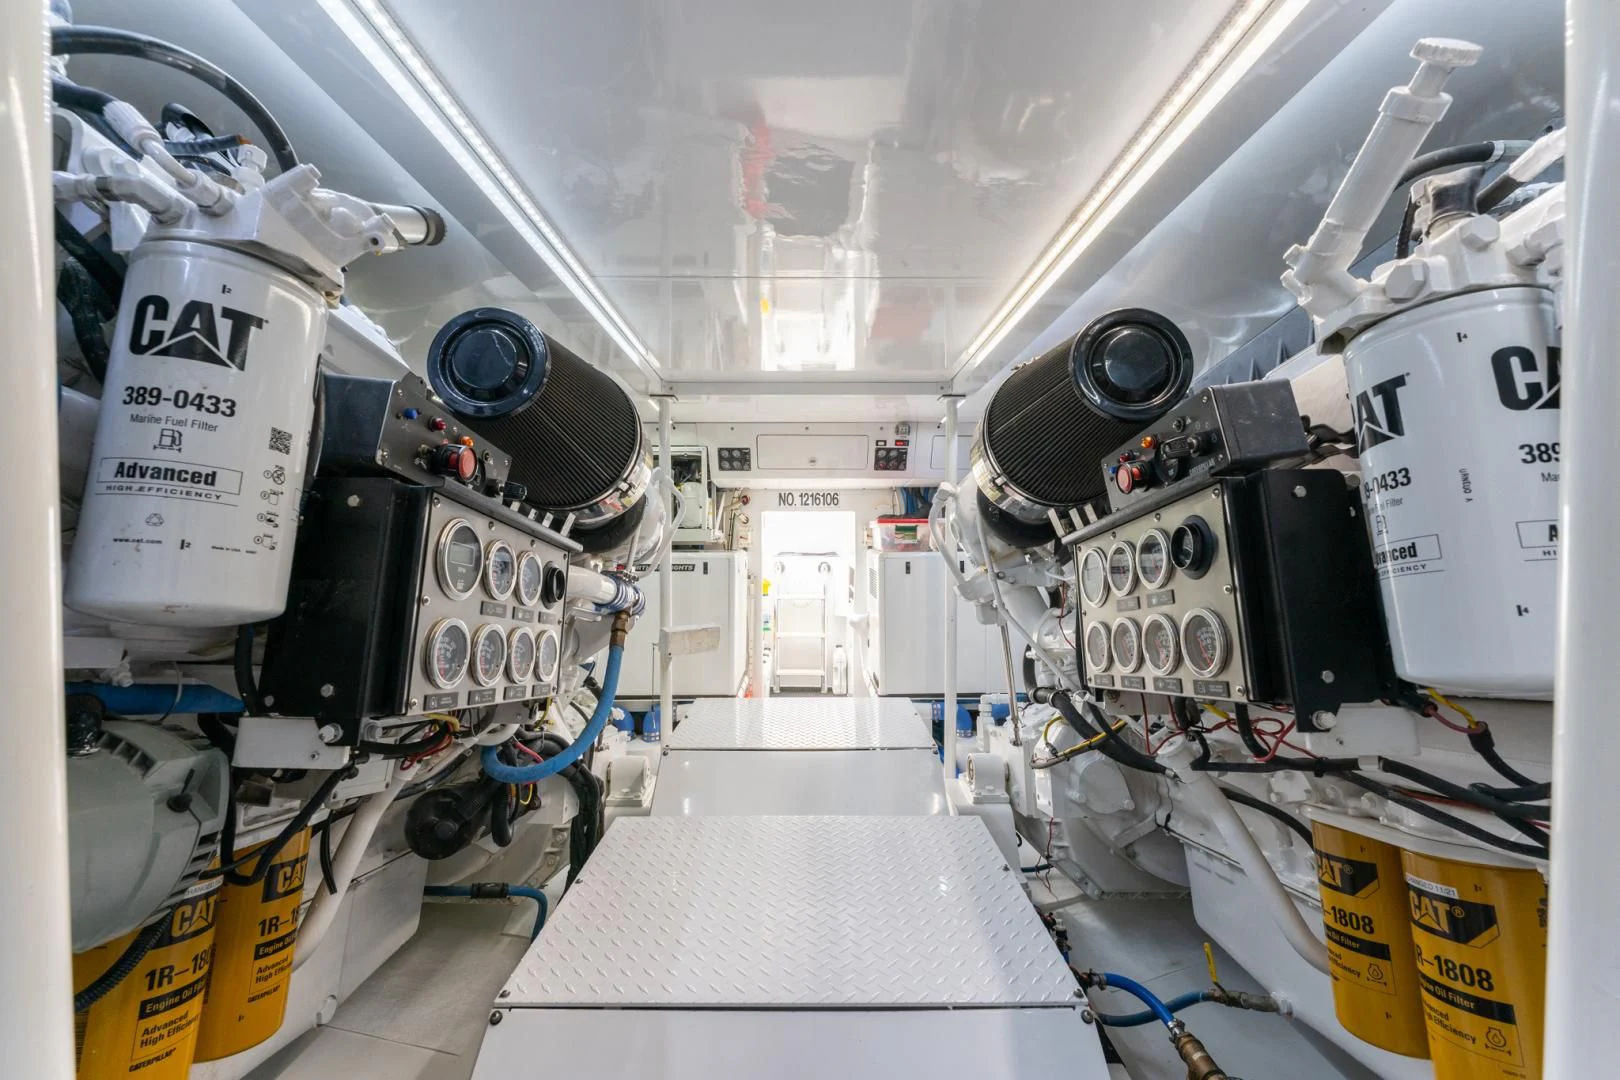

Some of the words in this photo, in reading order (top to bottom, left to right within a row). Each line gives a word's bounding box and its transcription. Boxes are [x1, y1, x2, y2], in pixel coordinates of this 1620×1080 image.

[129, 295, 264, 371] CAT
[122, 386, 237, 418] 389-0433
[130, 413, 162, 425] Marine
[165, 416, 188, 427] Fuel
[191, 420, 218, 432] Filter
[1351, 374, 1406, 456] AT
[114, 461, 217, 487] Advanced
[136, 486, 222, 500] EFFICIENCY
[778, 492, 797, 506] NO.
[799, 492, 839, 506] 1216106
[171, 895, 217, 938] CAT
[1322, 904, 1375, 935] -1808
[260, 942, 284, 954] Engine
[257, 956, 288, 974] Advanced
[256, 971, 273, 984] High
[145, 995, 181, 1014] Engine
[1435, 986, 1447, 998] Oil
[1448, 992, 1475, 1009] Filter
[142, 1010, 189, 1037] Advanced
[1433, 1015, 1476, 1044] Efficiency
[140, 1033, 165, 1049] High
[128, 1047, 177, 1073] CATERPILLAR
